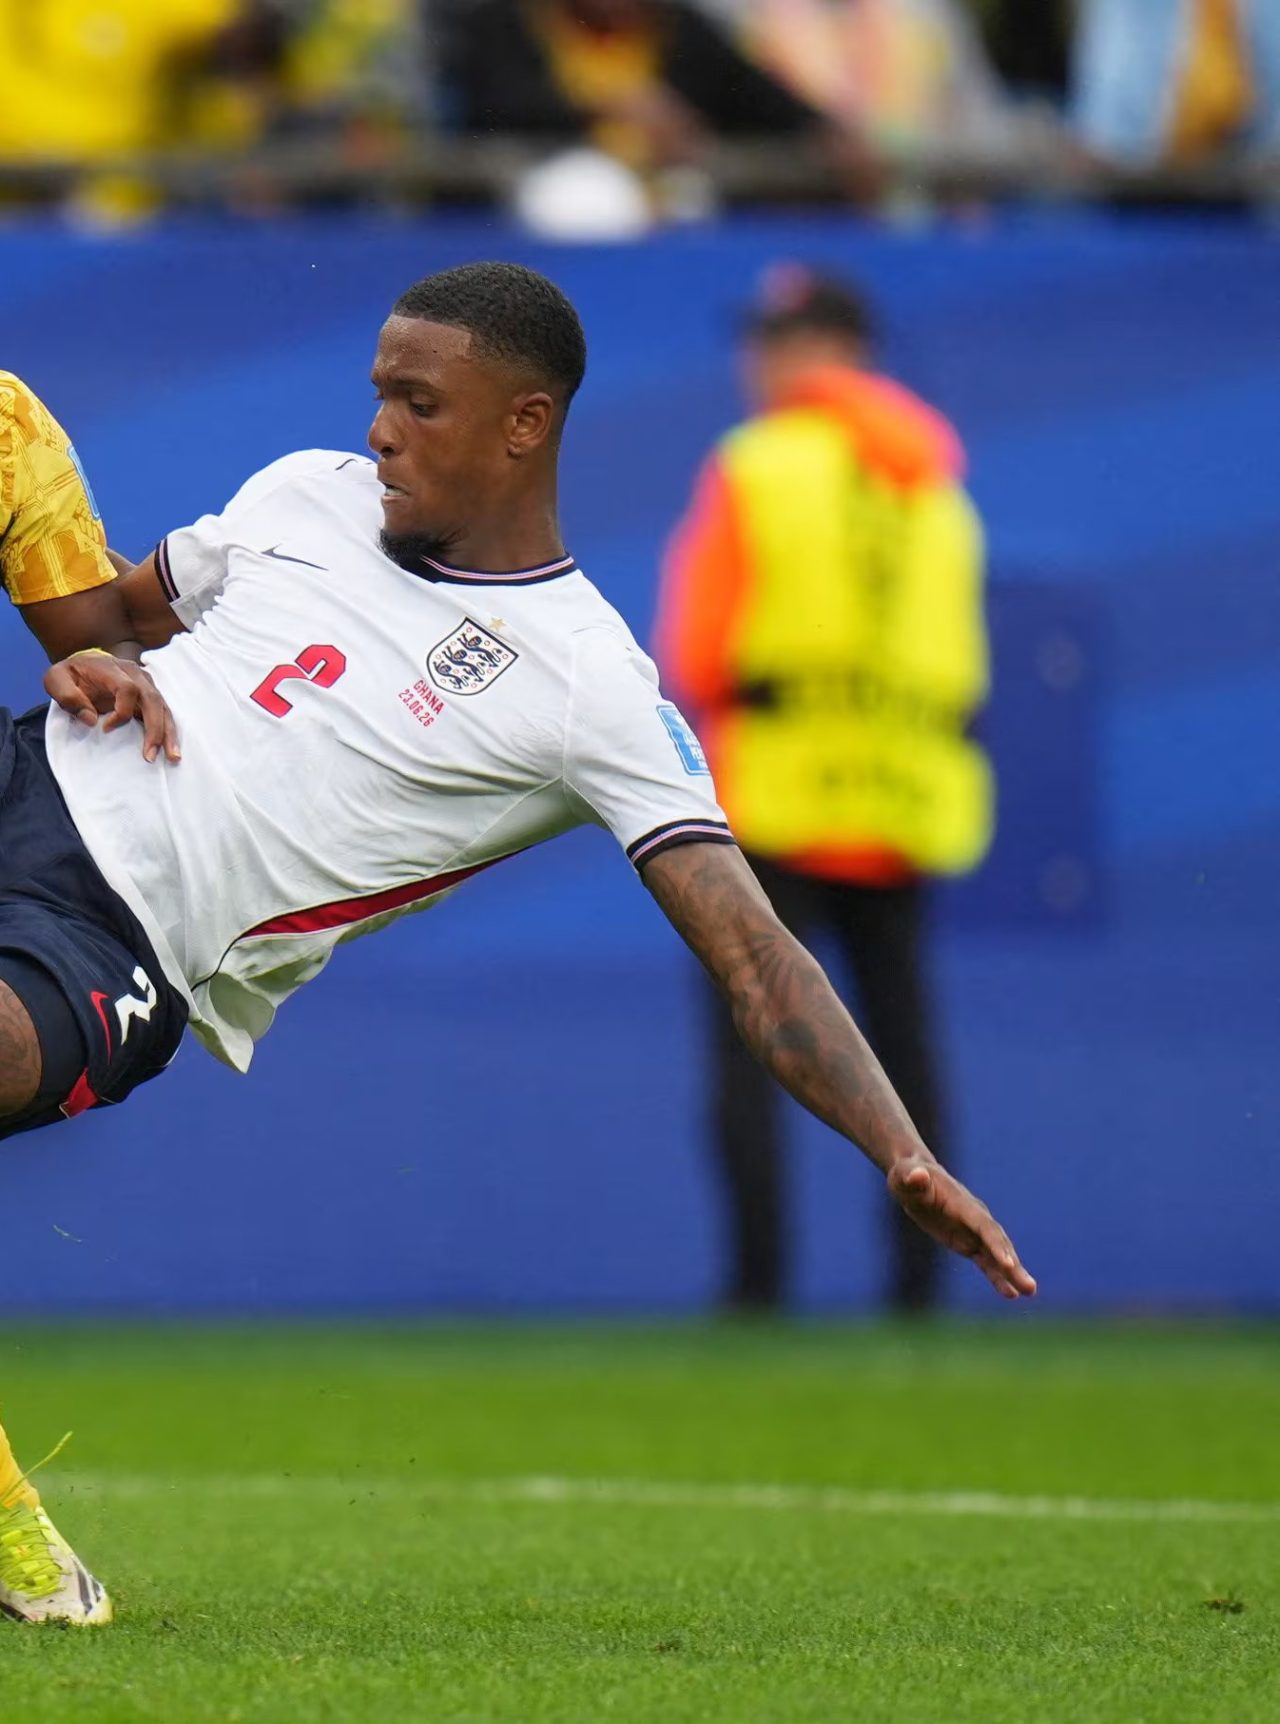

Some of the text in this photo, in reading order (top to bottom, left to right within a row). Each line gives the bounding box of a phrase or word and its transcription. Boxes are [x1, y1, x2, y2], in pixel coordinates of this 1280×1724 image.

[249, 644, 346, 719] 2
[398, 689, 435, 727] 23.06.26
[413, 679, 445, 715] GHANA
[114, 965, 157, 1046] 2
